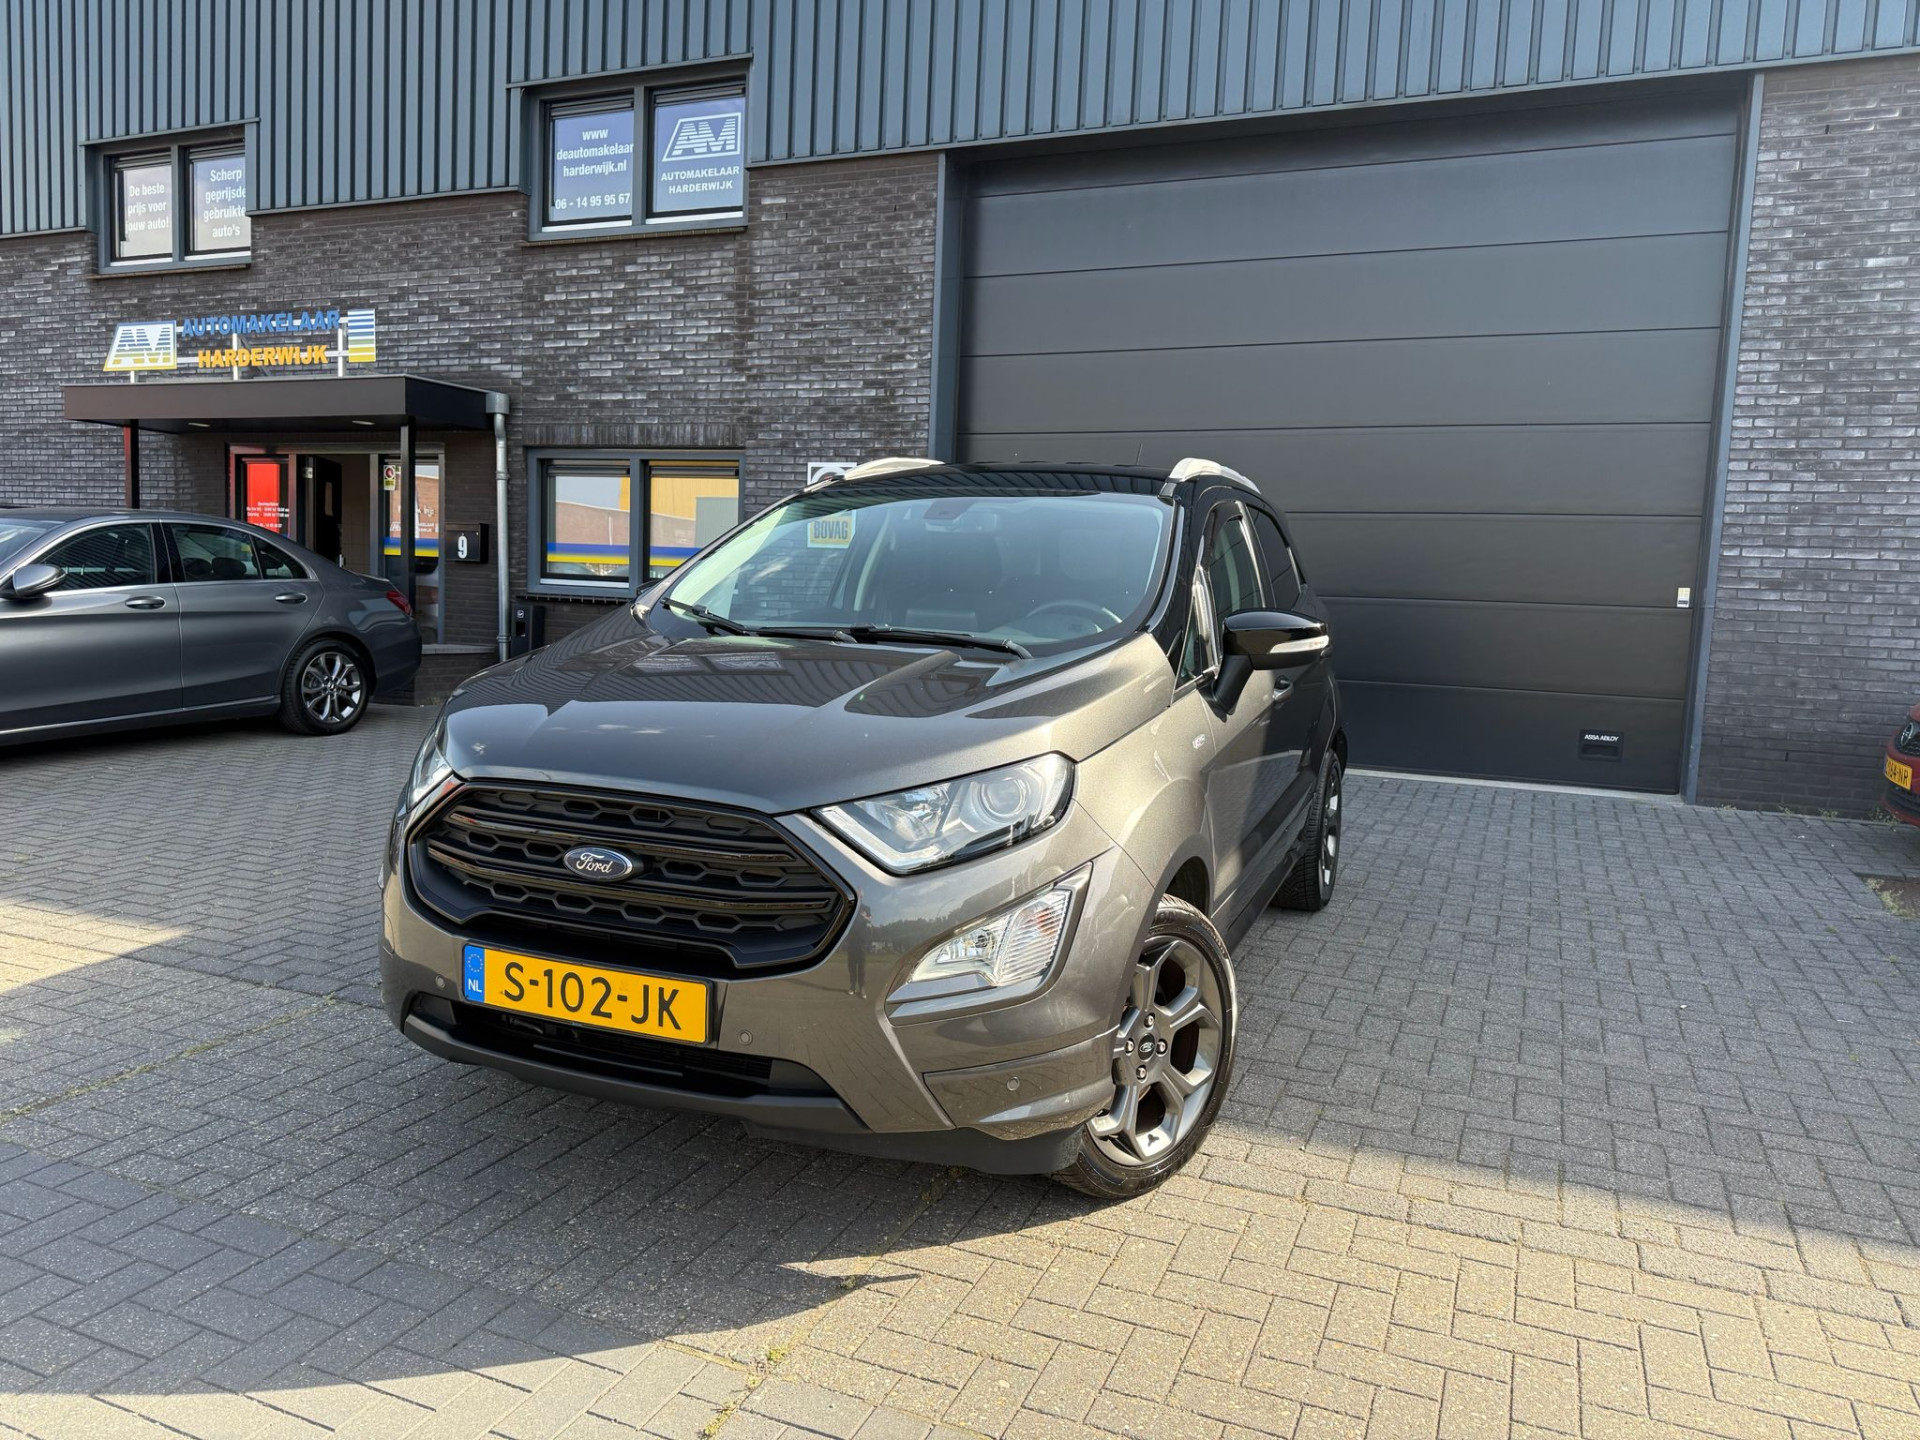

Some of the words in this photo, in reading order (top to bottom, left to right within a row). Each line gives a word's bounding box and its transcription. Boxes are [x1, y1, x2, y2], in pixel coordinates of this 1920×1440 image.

[582, 129, 609, 141] www
[556, 143, 634, 160] deautomakelaar
[210, 168, 242, 182] Scherp
[563, 160, 627, 177] harderwijk.nl
[660, 166, 740, 182] AUTOMAKELAAR
[129, 185, 140, 197] De
[141, 182, 165, 196] beste
[205, 187, 246, 204] geprijsde
[668, 180, 733, 194] HARDERWIJK
[127, 201, 146, 217] prijs
[148, 201, 167, 212] voor
[555, 198, 567, 210] 06
[576, 196, 588, 208] 14
[590, 195, 602, 207] 95
[604, 194, 616, 206] 95
[618, 192, 631, 204] 67
[203, 205, 246, 222] gebruikte
[125, 220, 146, 234] jouw
[147, 216, 169, 230] auto!
[212, 224, 241, 238] auto's
[181, 309, 341, 338] AUTOMAKELAAR
[197, 344, 329, 368] HARDERWIJK
[813, 520, 848, 540] BOVAG
[457, 535, 468, 559] 9
[576, 852, 614, 873] Ford
[468, 978, 482, 993] NL
[504, 961, 682, 1031] S-102-JK
